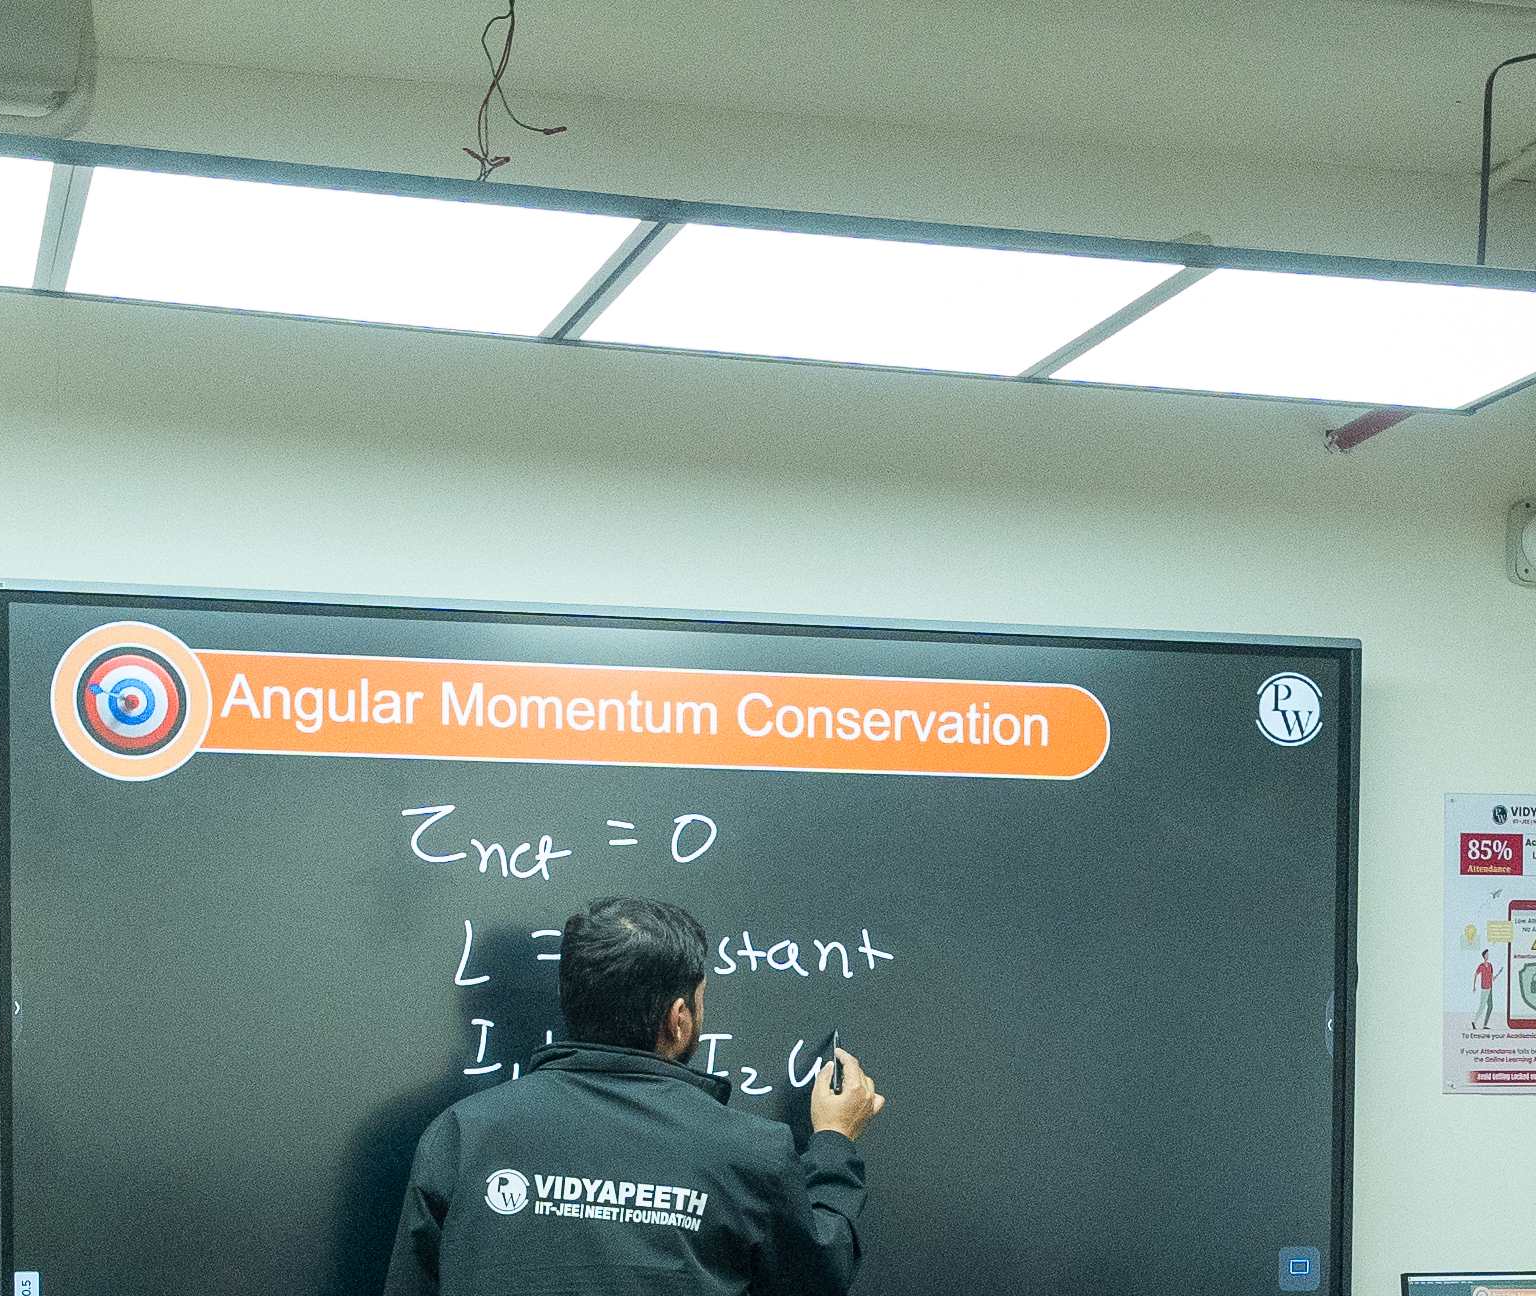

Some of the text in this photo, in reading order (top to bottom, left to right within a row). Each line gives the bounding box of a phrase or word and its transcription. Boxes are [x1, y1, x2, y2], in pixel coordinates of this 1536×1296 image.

[221, 673, 1050, 747] Angular Momentum Conservation
[607, 819, 638, 847] =
[1467, 838, 1513, 861] 85%
[1467, 865, 1512, 874] Attendance
[454, 919, 490, 986] L
[714, 929, 894, 978] stant
[534, 1174, 709, 1217] VIDYAPEETH
[584, 1206, 620, 1221] NEET
[624, 1208, 702, 1232] FOUNDATION
